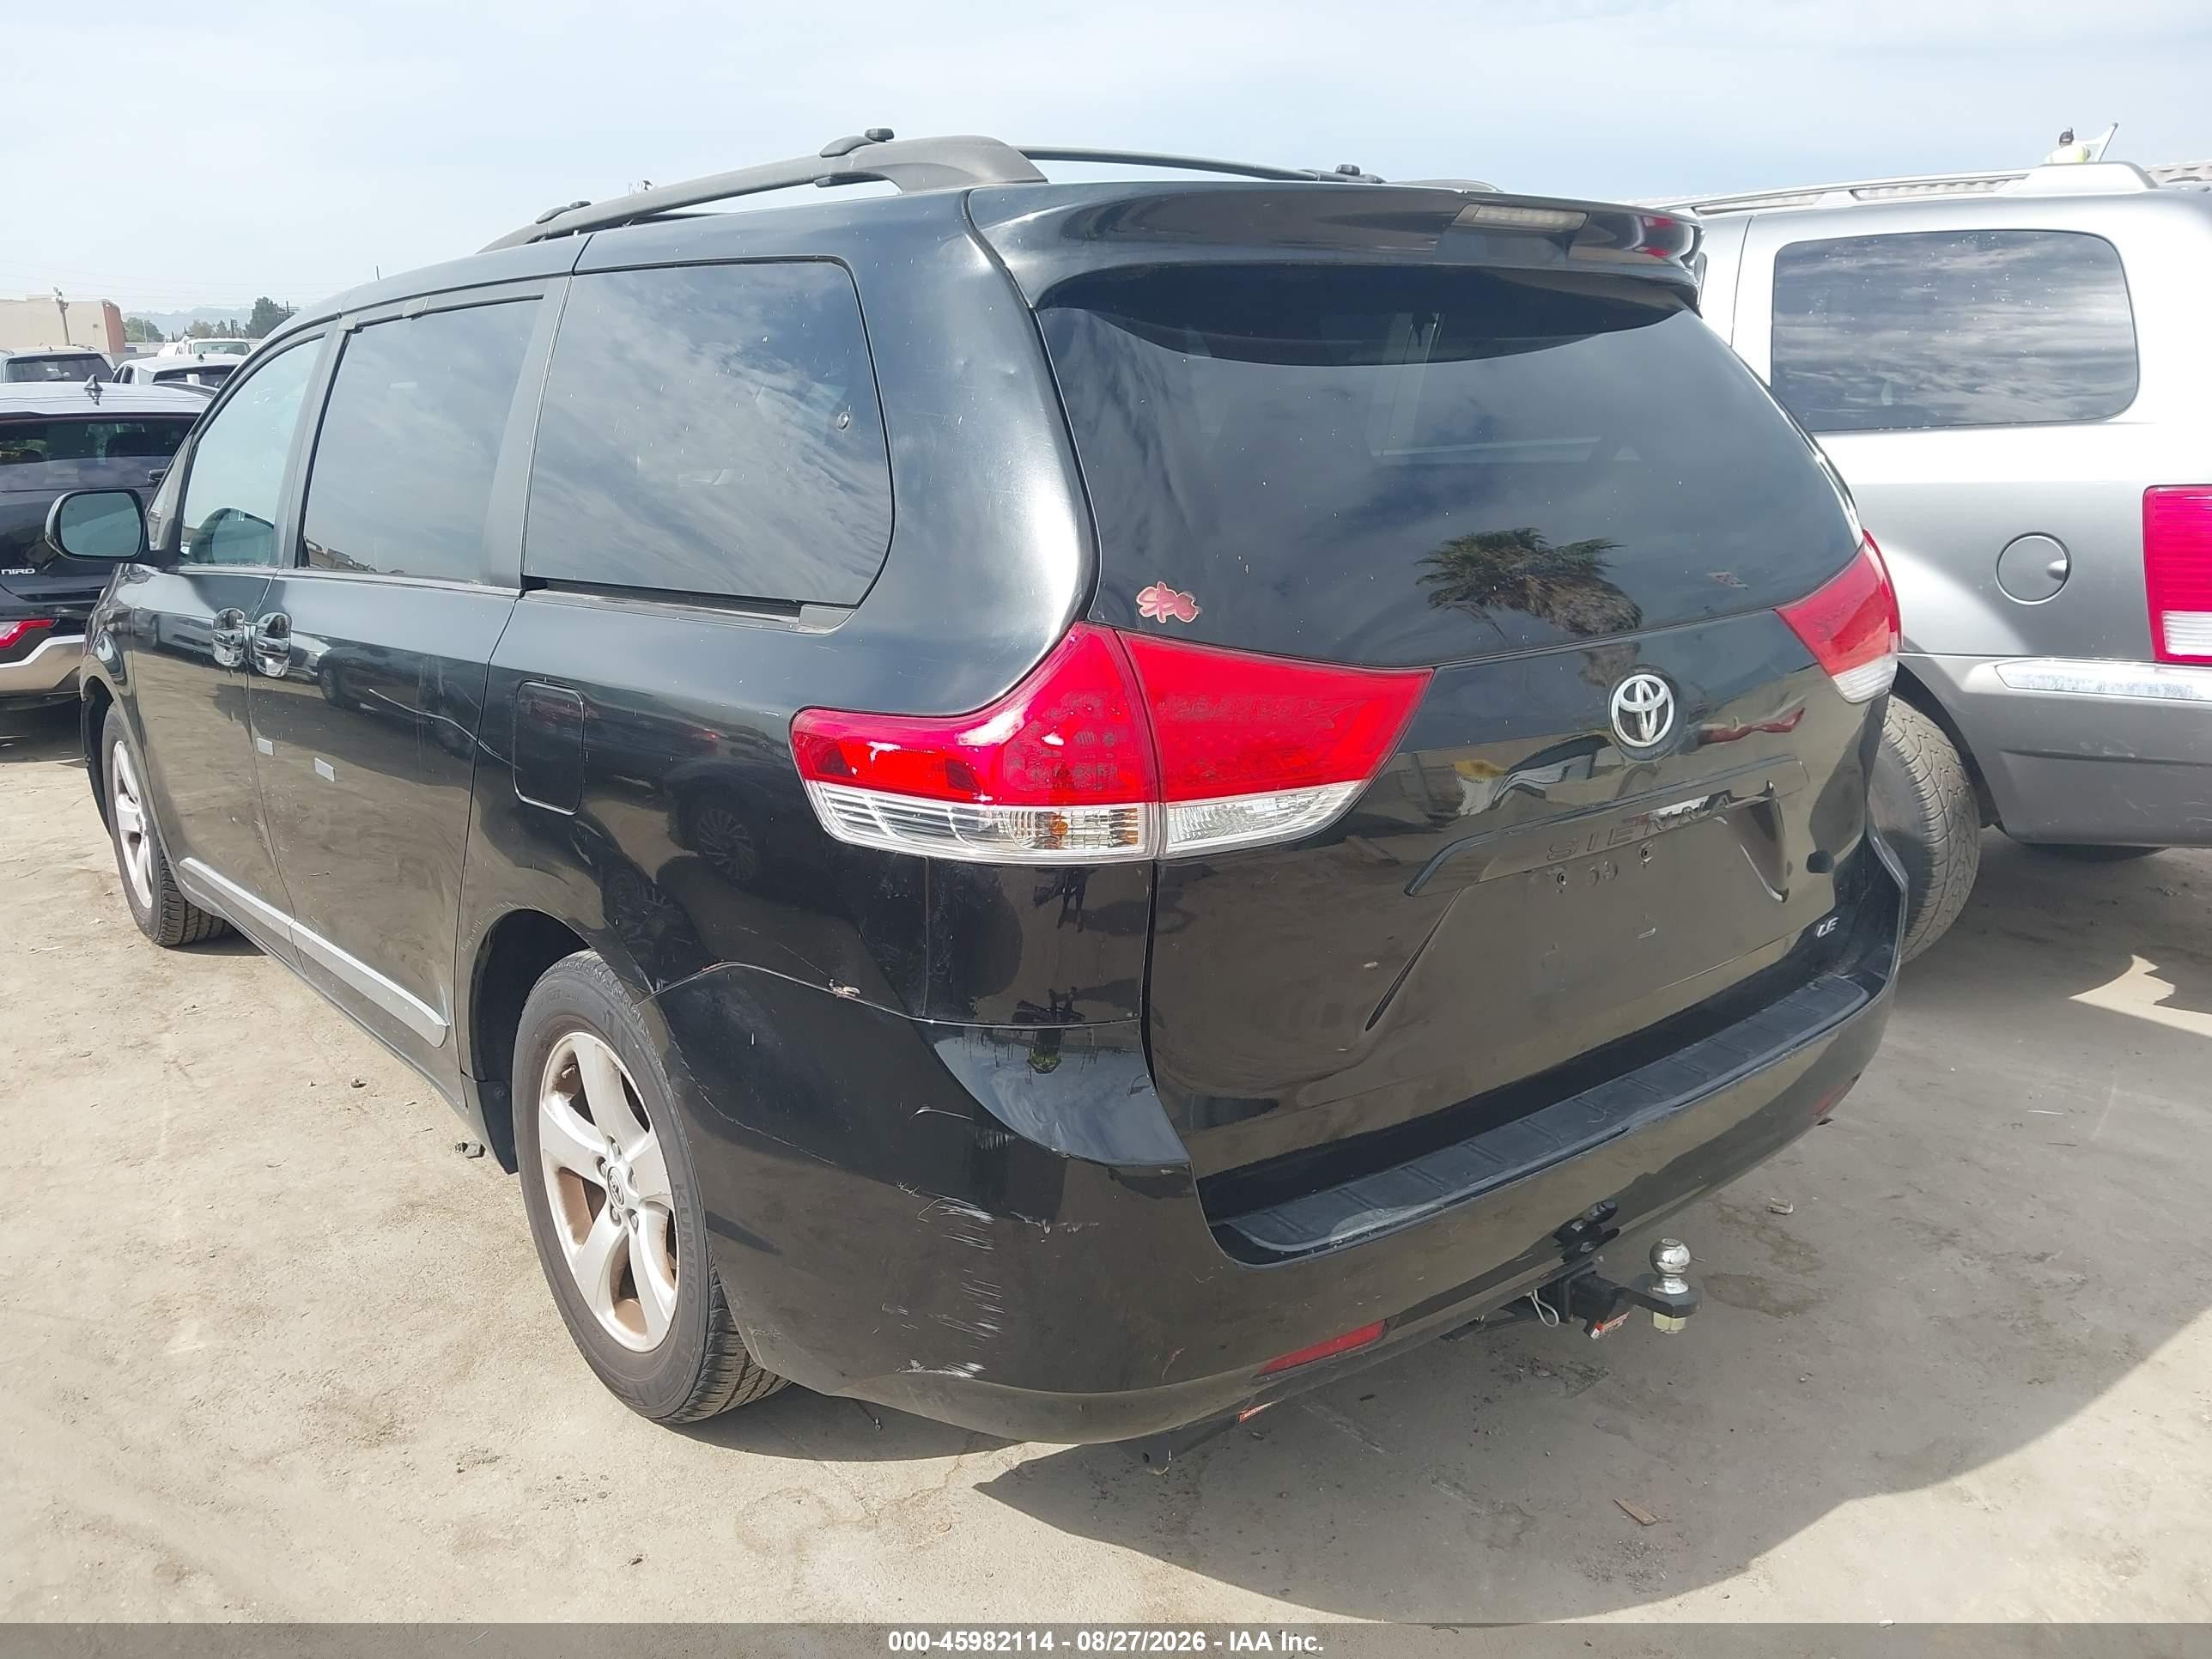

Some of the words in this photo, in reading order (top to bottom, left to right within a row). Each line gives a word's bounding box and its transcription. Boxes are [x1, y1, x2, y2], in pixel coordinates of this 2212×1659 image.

[1547, 793, 1730, 860] SIENNA
[1816, 916, 1839, 938] LE
[675, 1182, 696, 1304] KUMHO
